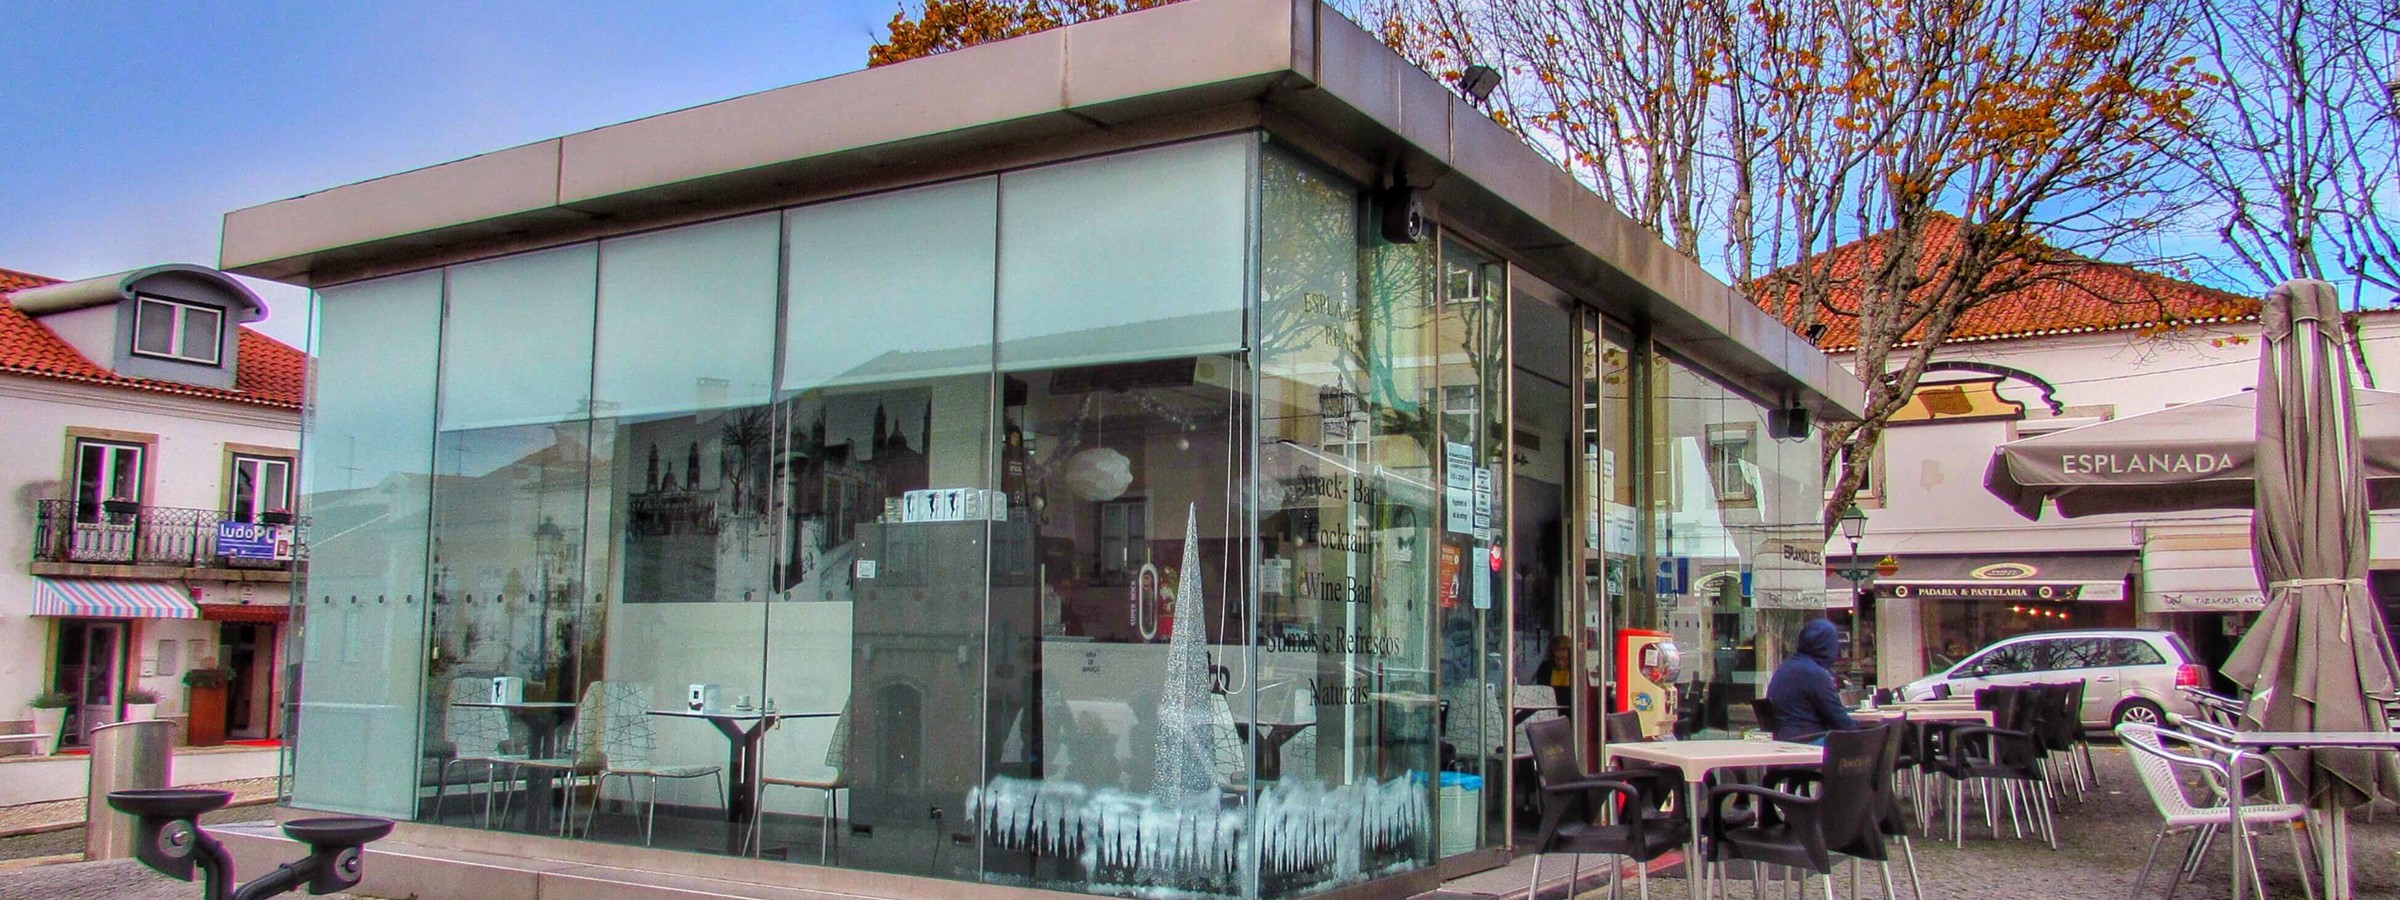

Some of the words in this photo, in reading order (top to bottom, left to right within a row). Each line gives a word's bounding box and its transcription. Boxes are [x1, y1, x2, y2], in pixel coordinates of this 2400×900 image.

[2061, 453, 2233, 474] ESPLANADA
[1353, 476, 1377, 506] Bar
[1304, 571, 1342, 602] Wine
[1346, 577, 1371, 605] Bar
[1918, 588, 1958, 597] PADARIA
[1960, 589, 1967, 597] &
[1971, 588, 2028, 597] PASTELARIA
[1266, 627, 1318, 653] Sumos
[1336, 626, 1400, 656] Refrescos
[1309, 678, 1368, 707] Naturais
